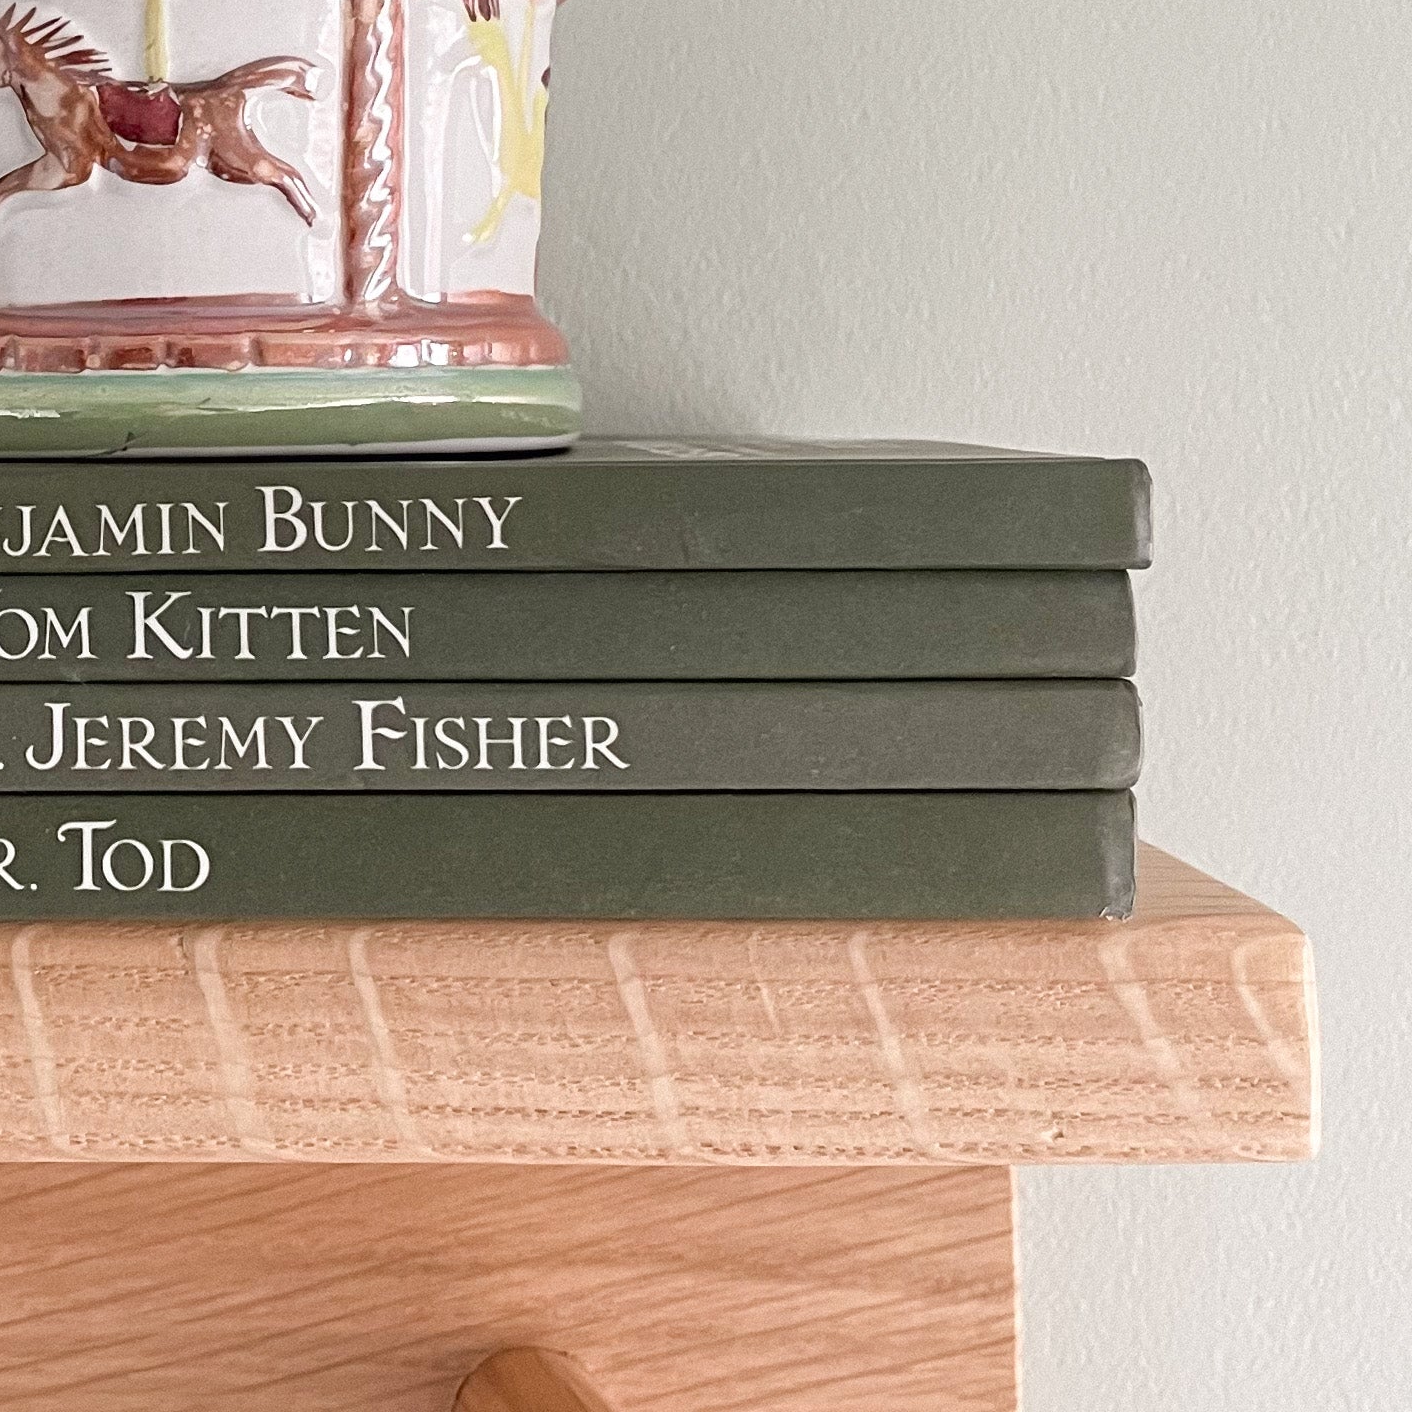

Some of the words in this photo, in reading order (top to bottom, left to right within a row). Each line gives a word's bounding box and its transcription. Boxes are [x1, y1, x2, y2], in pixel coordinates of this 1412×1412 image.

[255, 485, 523, 552] BUNNY
[125, 591, 415, 660] KITTEN
[25, 702, 324, 771] JEREMY
[351, 695, 631, 771] FISHER
[57, 819, 210, 892] TOD
